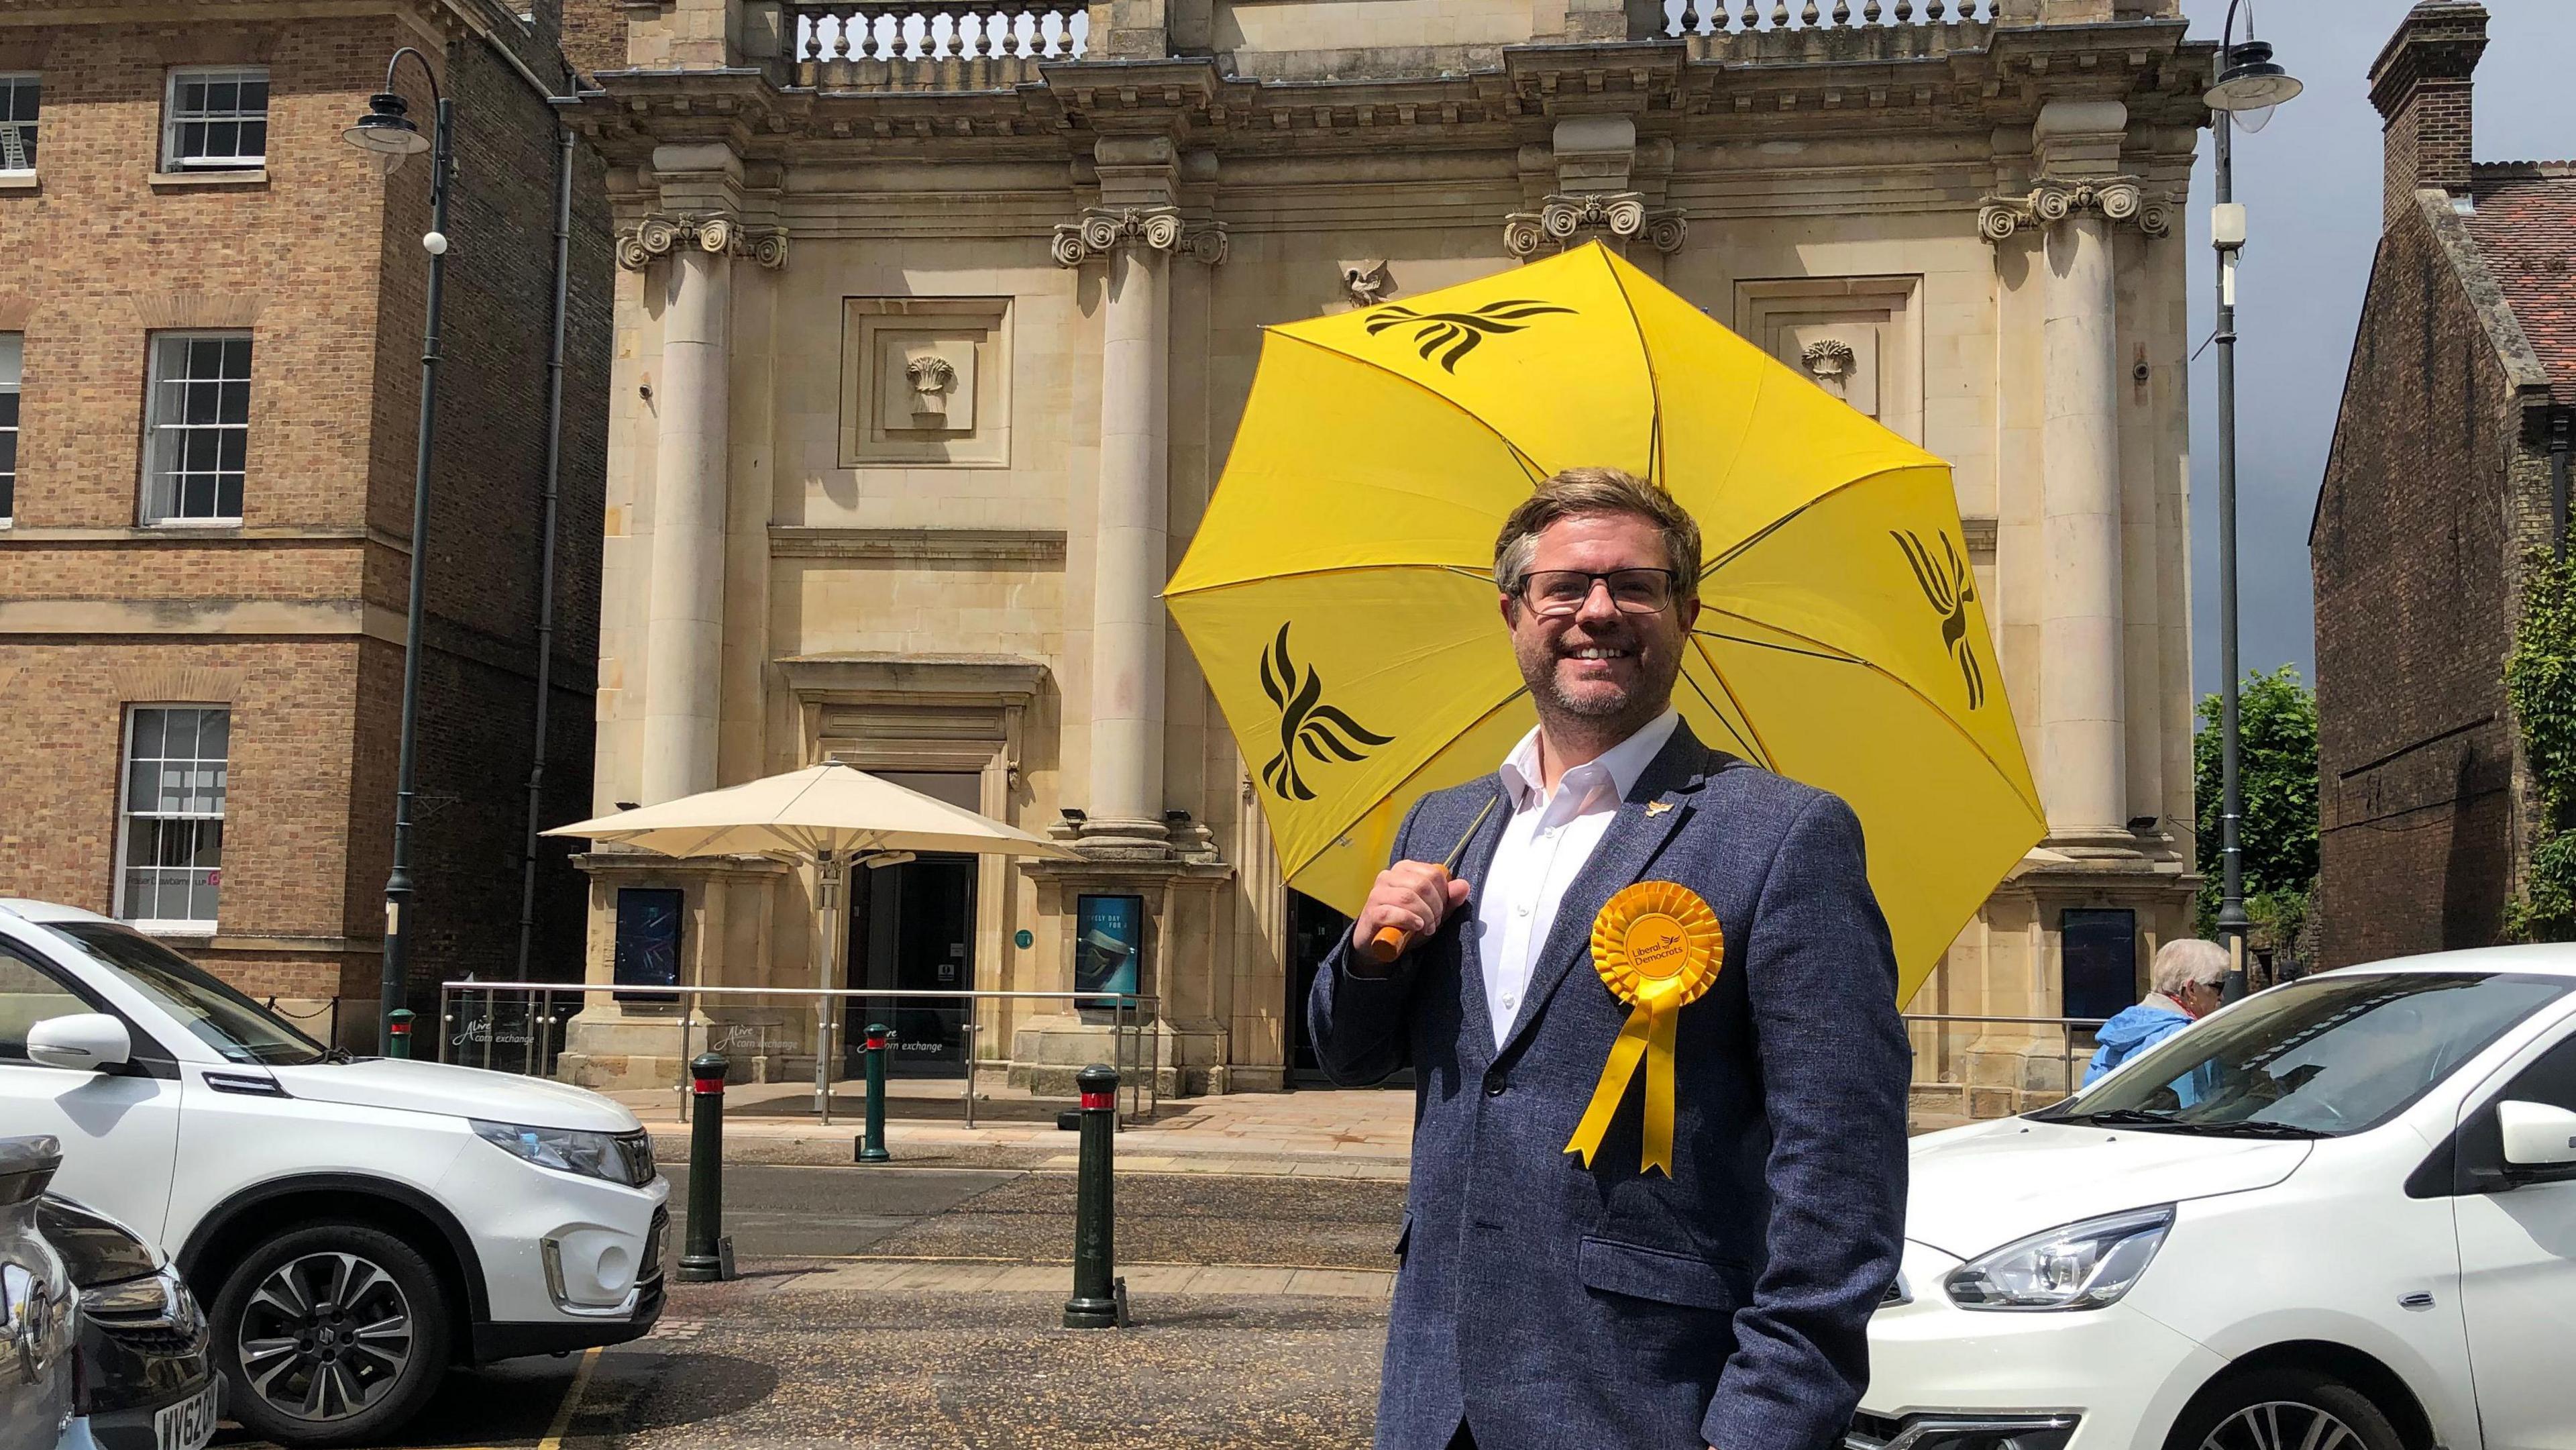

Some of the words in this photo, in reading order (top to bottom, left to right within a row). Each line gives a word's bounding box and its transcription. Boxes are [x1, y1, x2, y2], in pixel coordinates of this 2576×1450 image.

[1632, 941, 1661, 957] Liberal
[1635, 947, 1683, 965] Democrats
[495, 1034, 535, 1045] exchange
[885, 1042, 899, 1050] orn
[902, 1041, 943, 1053] exchange
